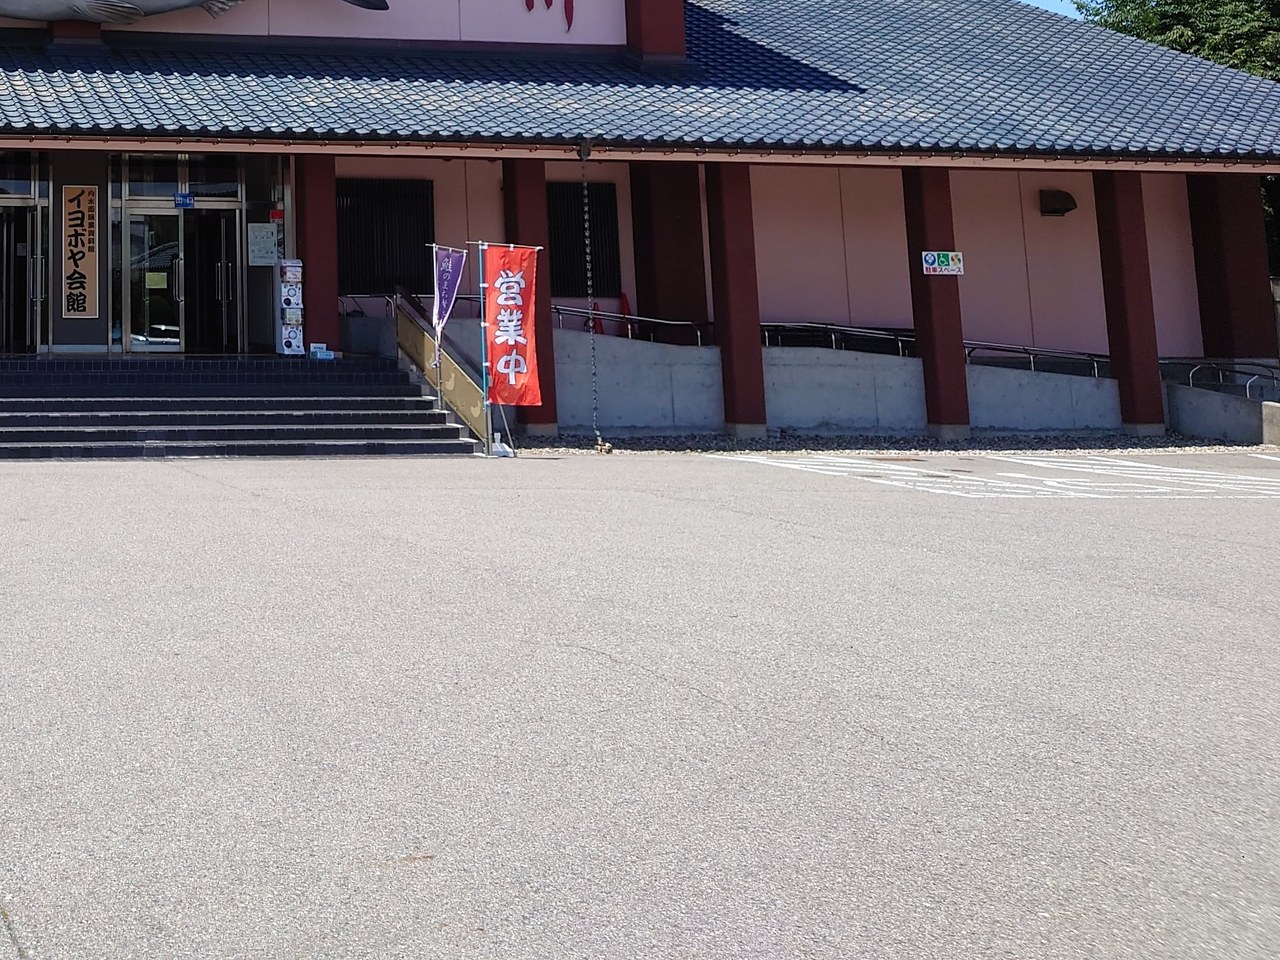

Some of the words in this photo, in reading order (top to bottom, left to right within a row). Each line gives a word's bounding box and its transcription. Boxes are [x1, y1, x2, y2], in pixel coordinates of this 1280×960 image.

[66, 189, 87, 313] イヨボヤ会館
[493, 269, 529, 385] 営業中
